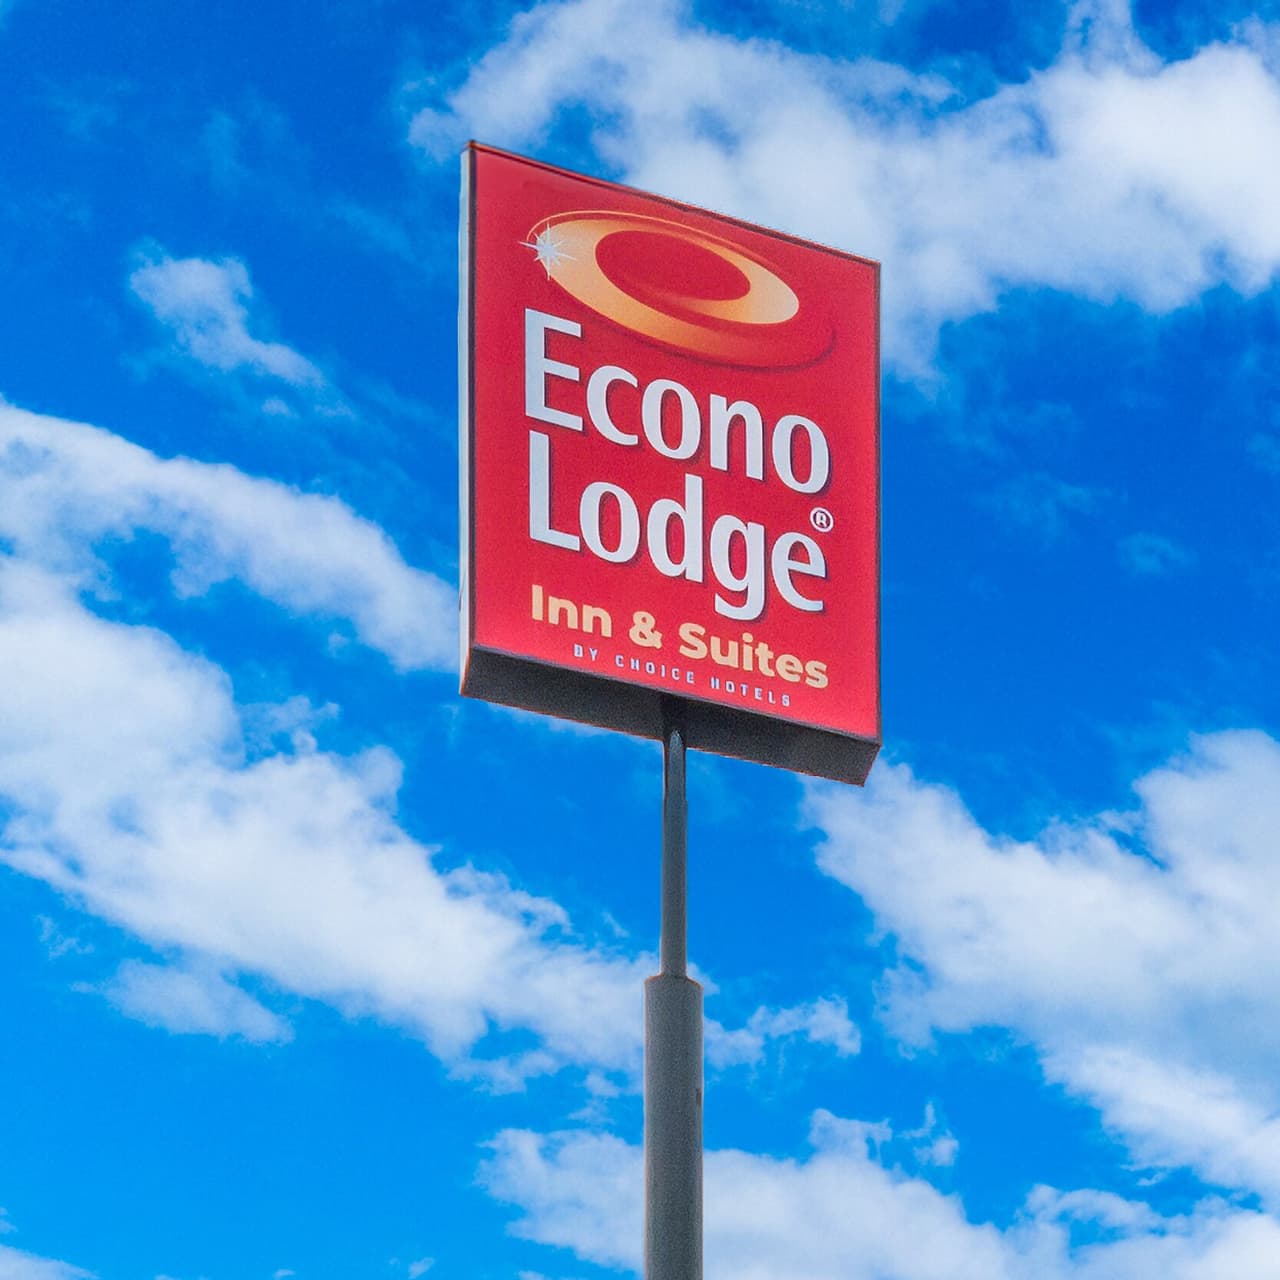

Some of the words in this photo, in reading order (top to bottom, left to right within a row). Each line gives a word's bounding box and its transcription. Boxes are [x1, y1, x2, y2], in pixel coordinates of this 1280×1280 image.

[524, 307, 830, 494] Econo
[529, 430, 828, 621] Lodge
[531, 584, 612, 638] Inn
[628, 611, 663, 649] &
[678, 622, 829, 689] Suites
[573, 643, 598, 661] BY
[615, 654, 695, 685] CHOICE
[710, 676, 791, 708] HOTELS
